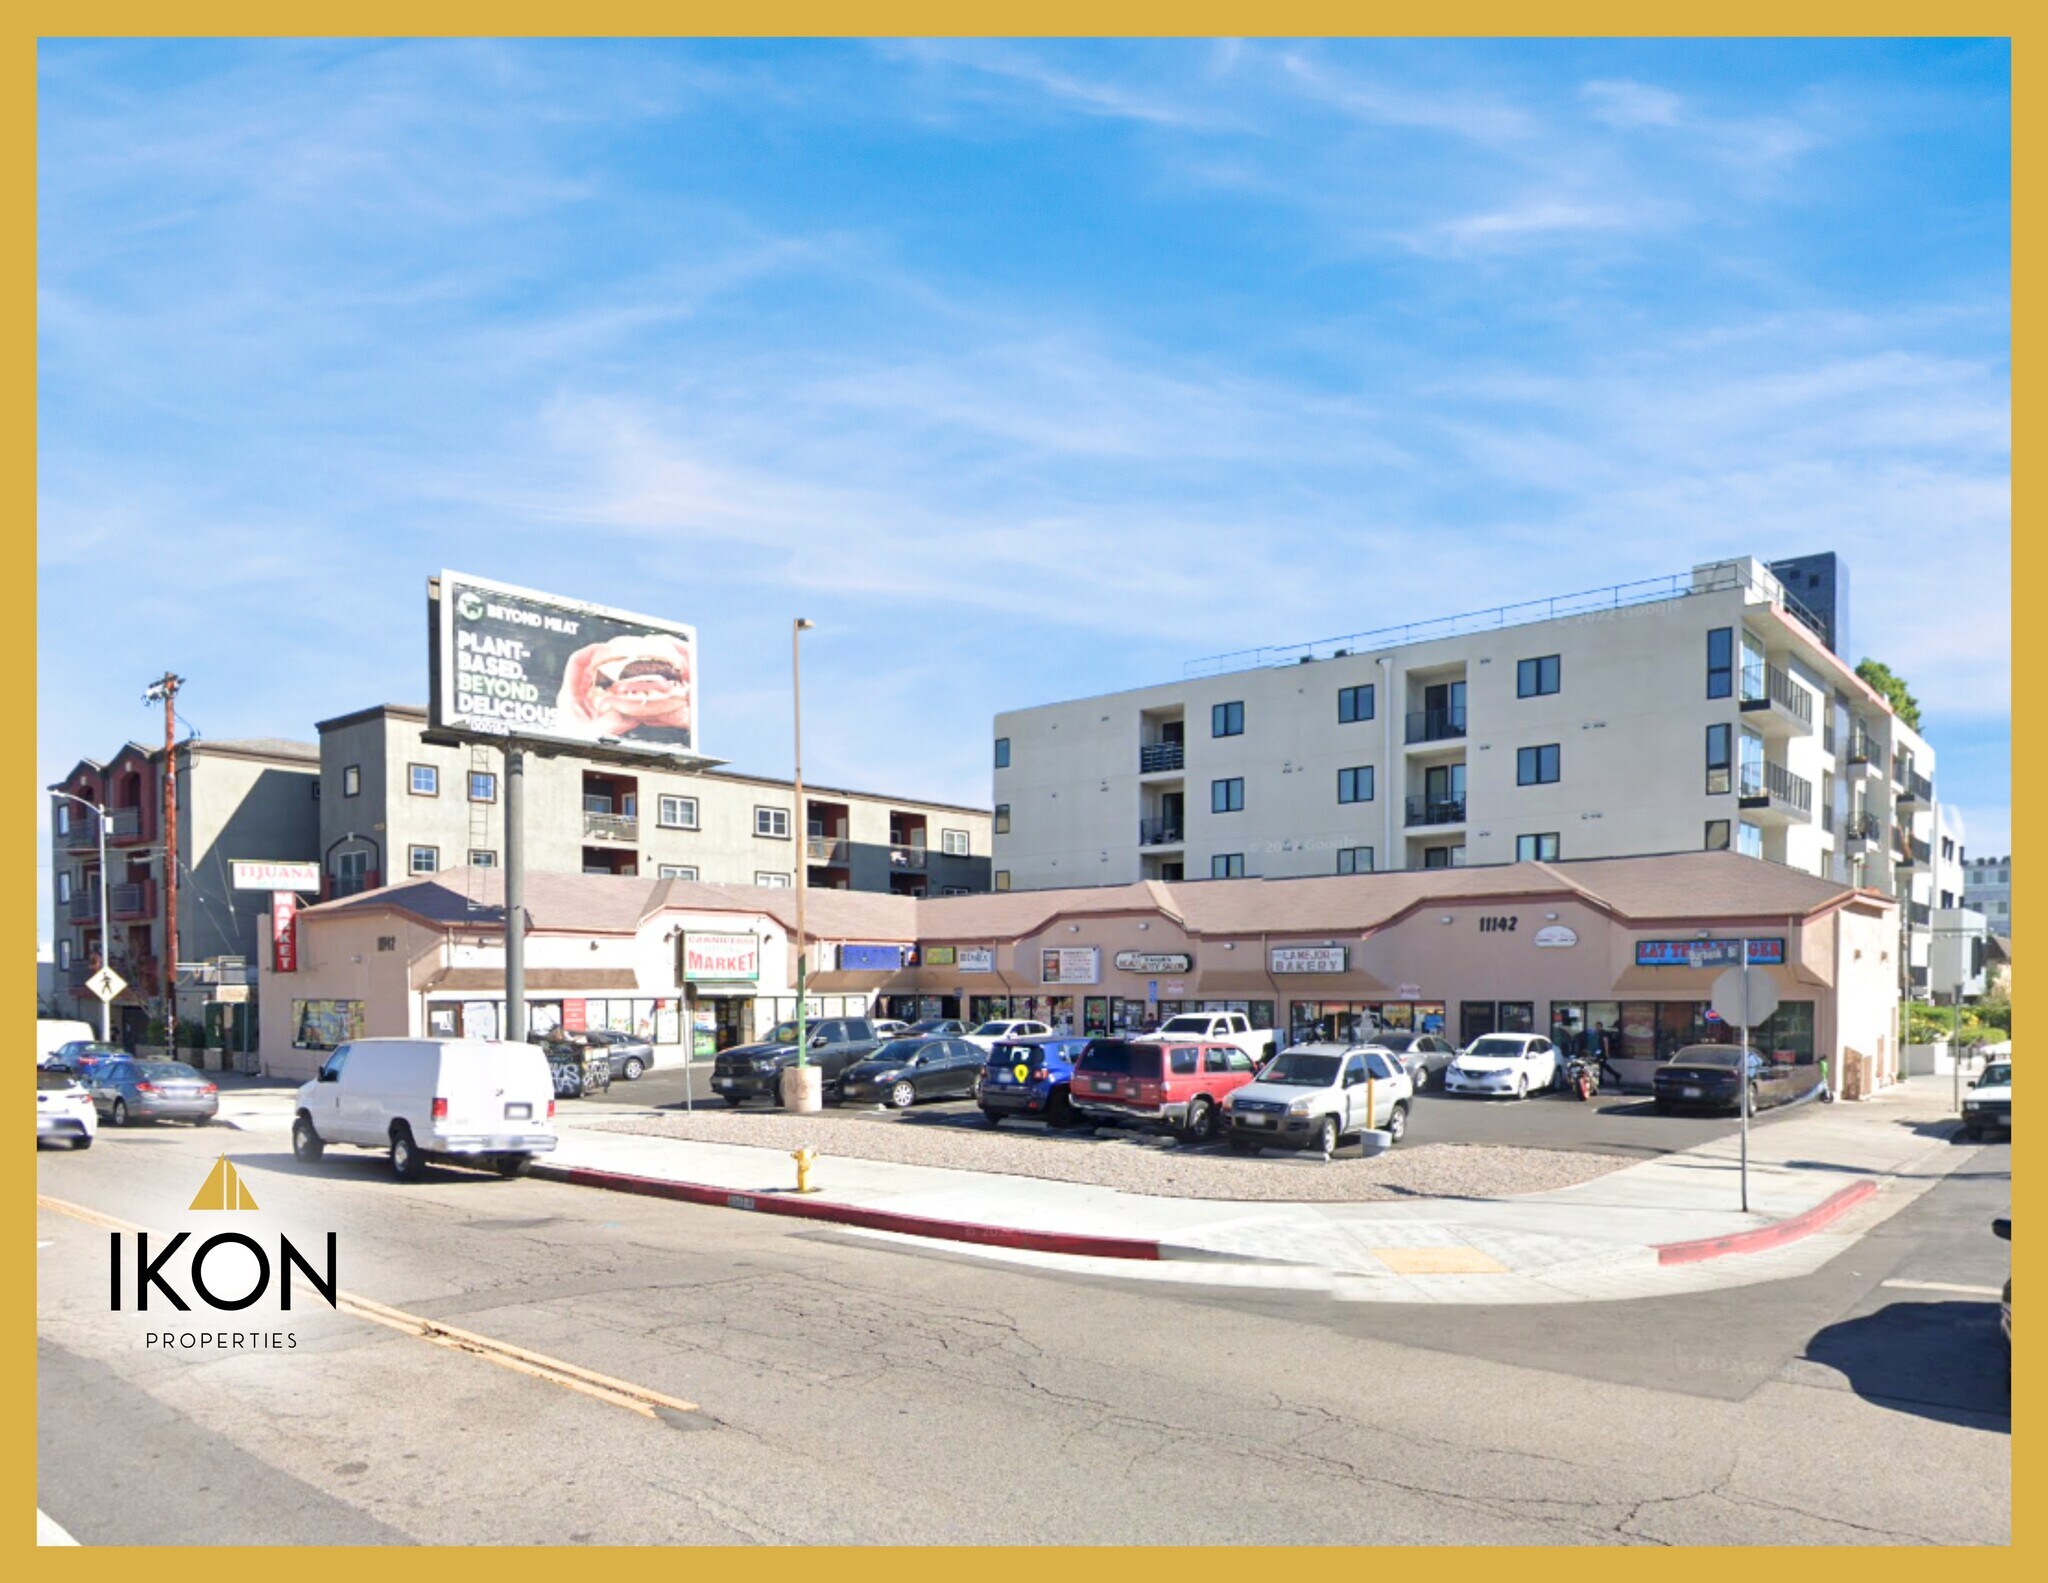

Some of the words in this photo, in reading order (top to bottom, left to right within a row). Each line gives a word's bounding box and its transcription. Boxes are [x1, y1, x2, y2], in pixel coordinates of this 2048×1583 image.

[487, 603, 542, 628] BEYOND
[544, 615, 580, 635] MEAT
[458, 629, 531, 660] PLANT-
[458, 650, 528, 681] BASED.
[458, 671, 539, 702] BEYOND
[238, 864, 316, 881] TIJUANA
[275, 890, 294, 970] MARKET
[1479, 916, 1518, 932] 11142
[688, 949, 755, 971] MARKET
[1282, 951, 1297, 960] LA
[1298, 951, 1330, 960] MEJOR
[1638, 942, 1667, 958] EAT
[1275, 961, 1338, 971] BAKERY
